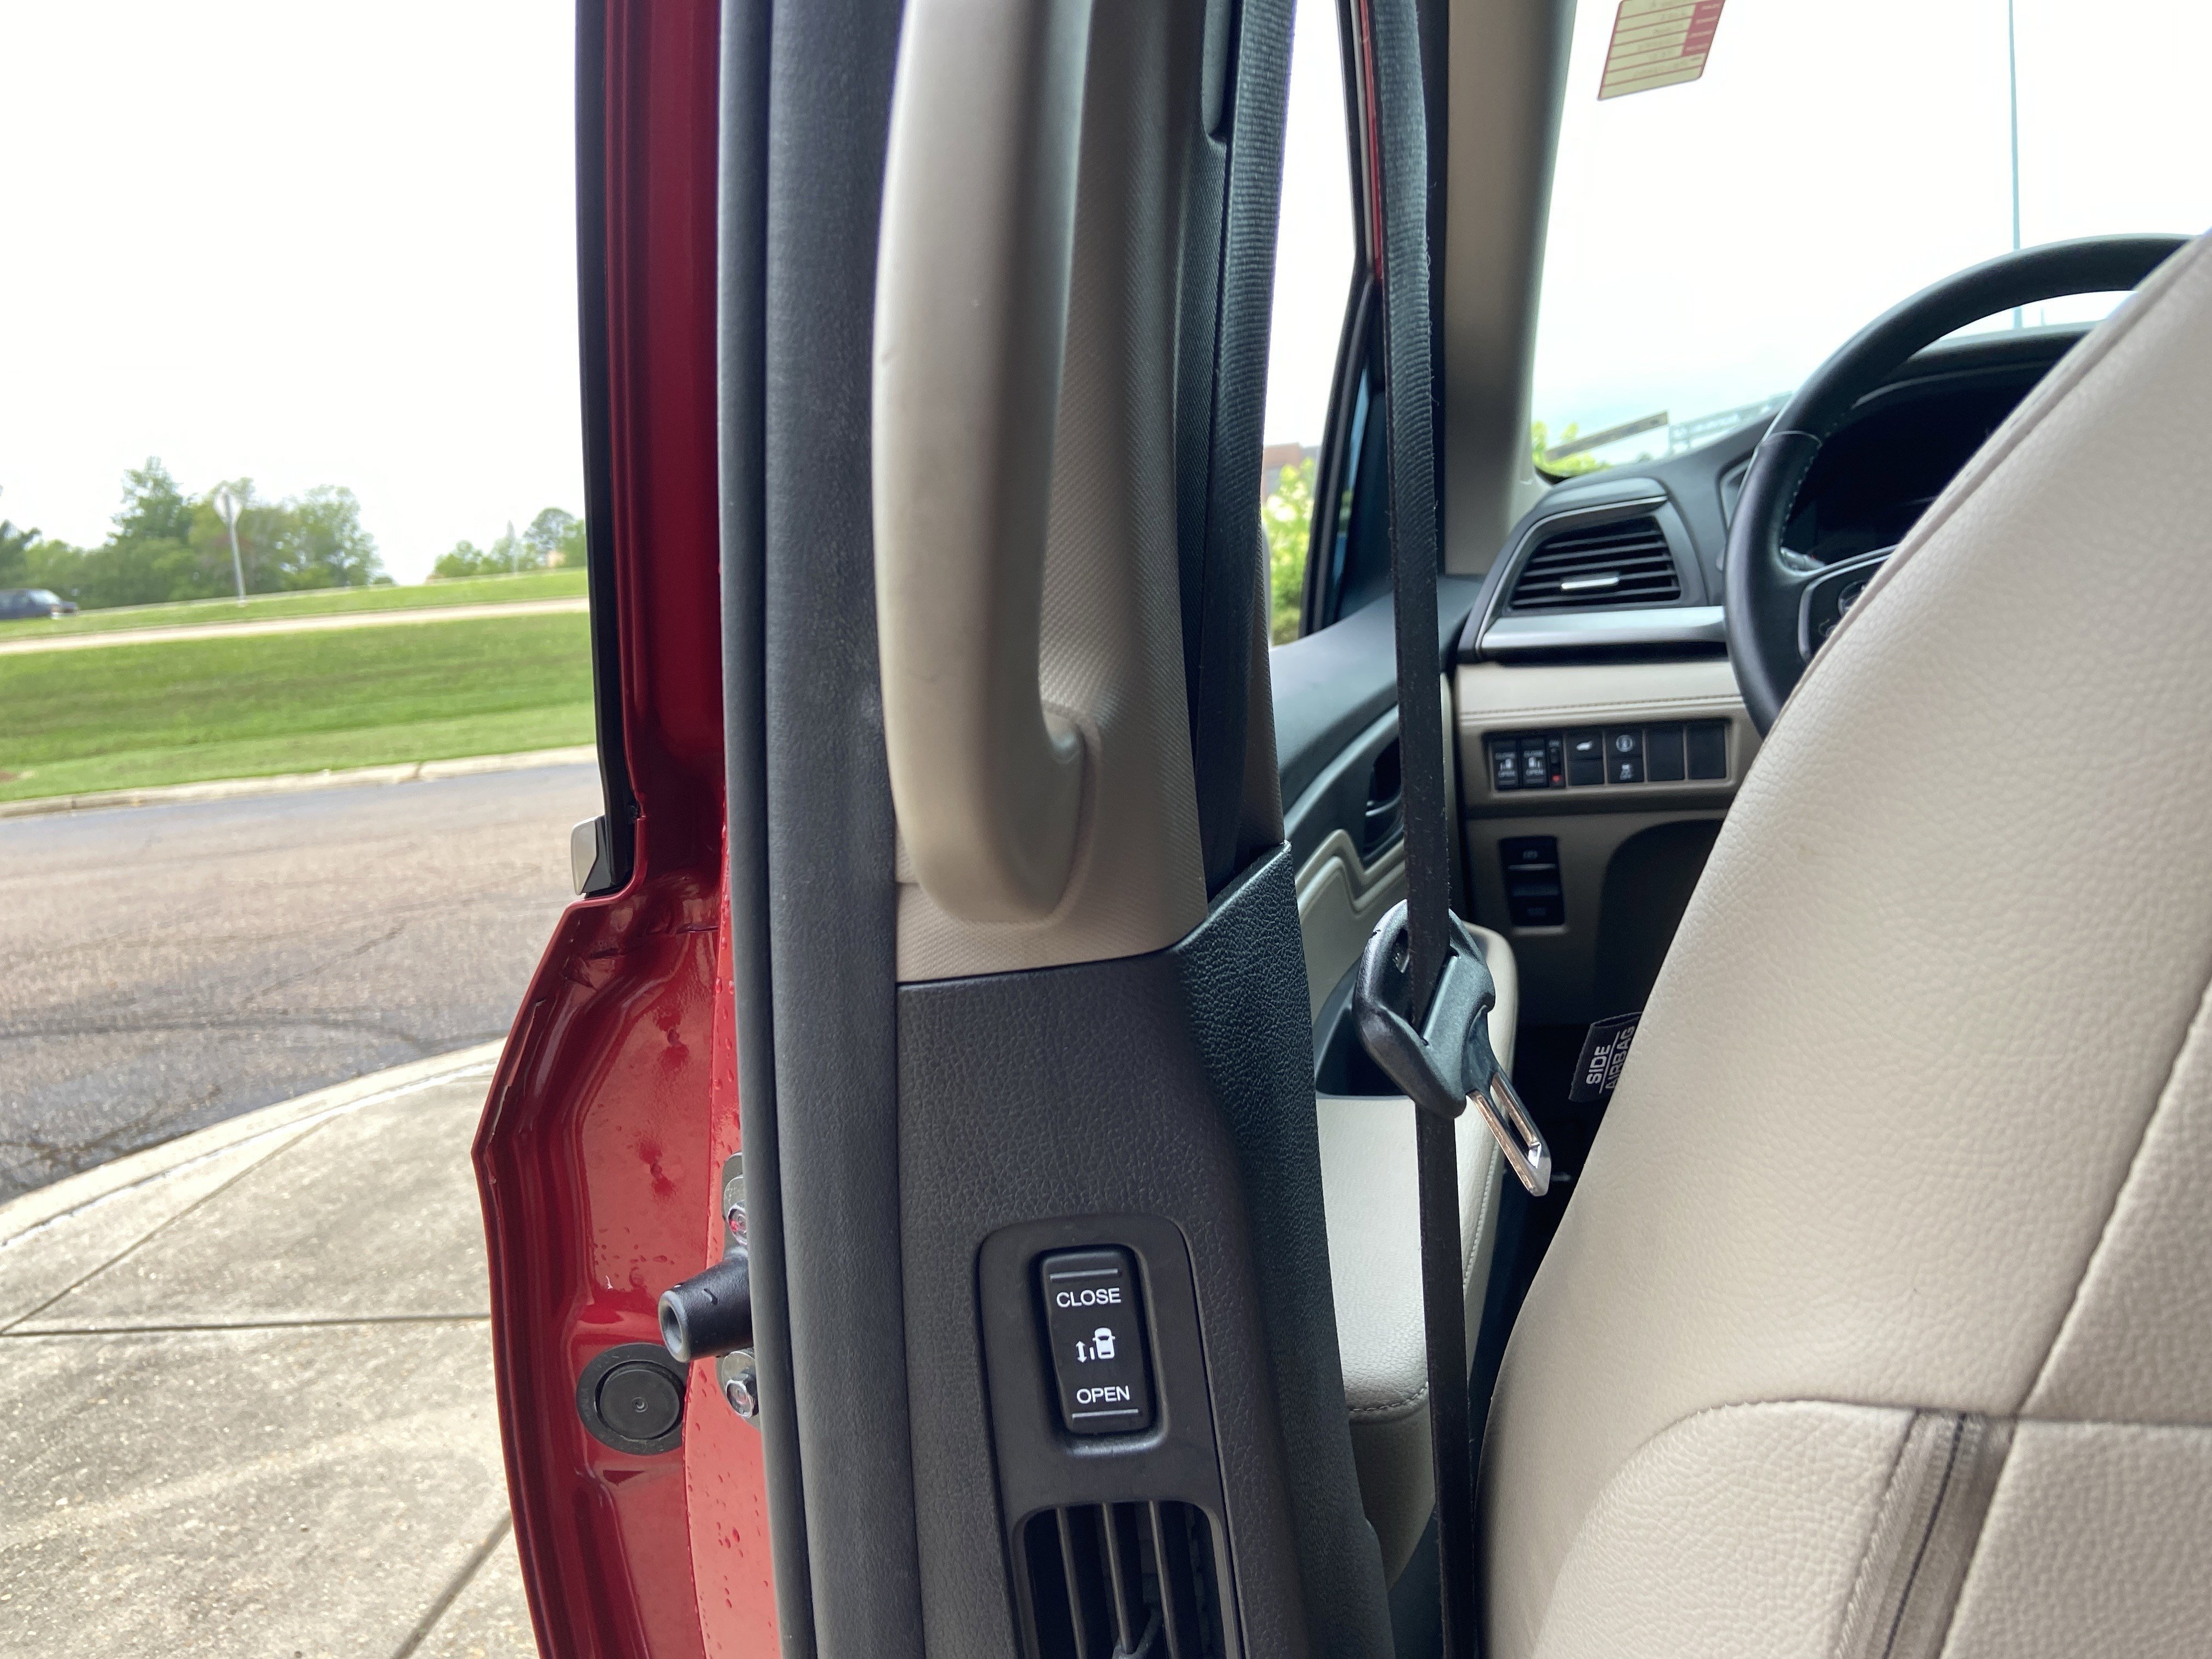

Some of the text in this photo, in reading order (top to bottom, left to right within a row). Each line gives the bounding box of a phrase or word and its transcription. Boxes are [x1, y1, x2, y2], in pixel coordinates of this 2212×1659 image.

[1586, 1045, 1611, 1085] SIDE
[1056, 1287, 1121, 1308] CLOSE
[1076, 1385, 1130, 1404] OPEN
